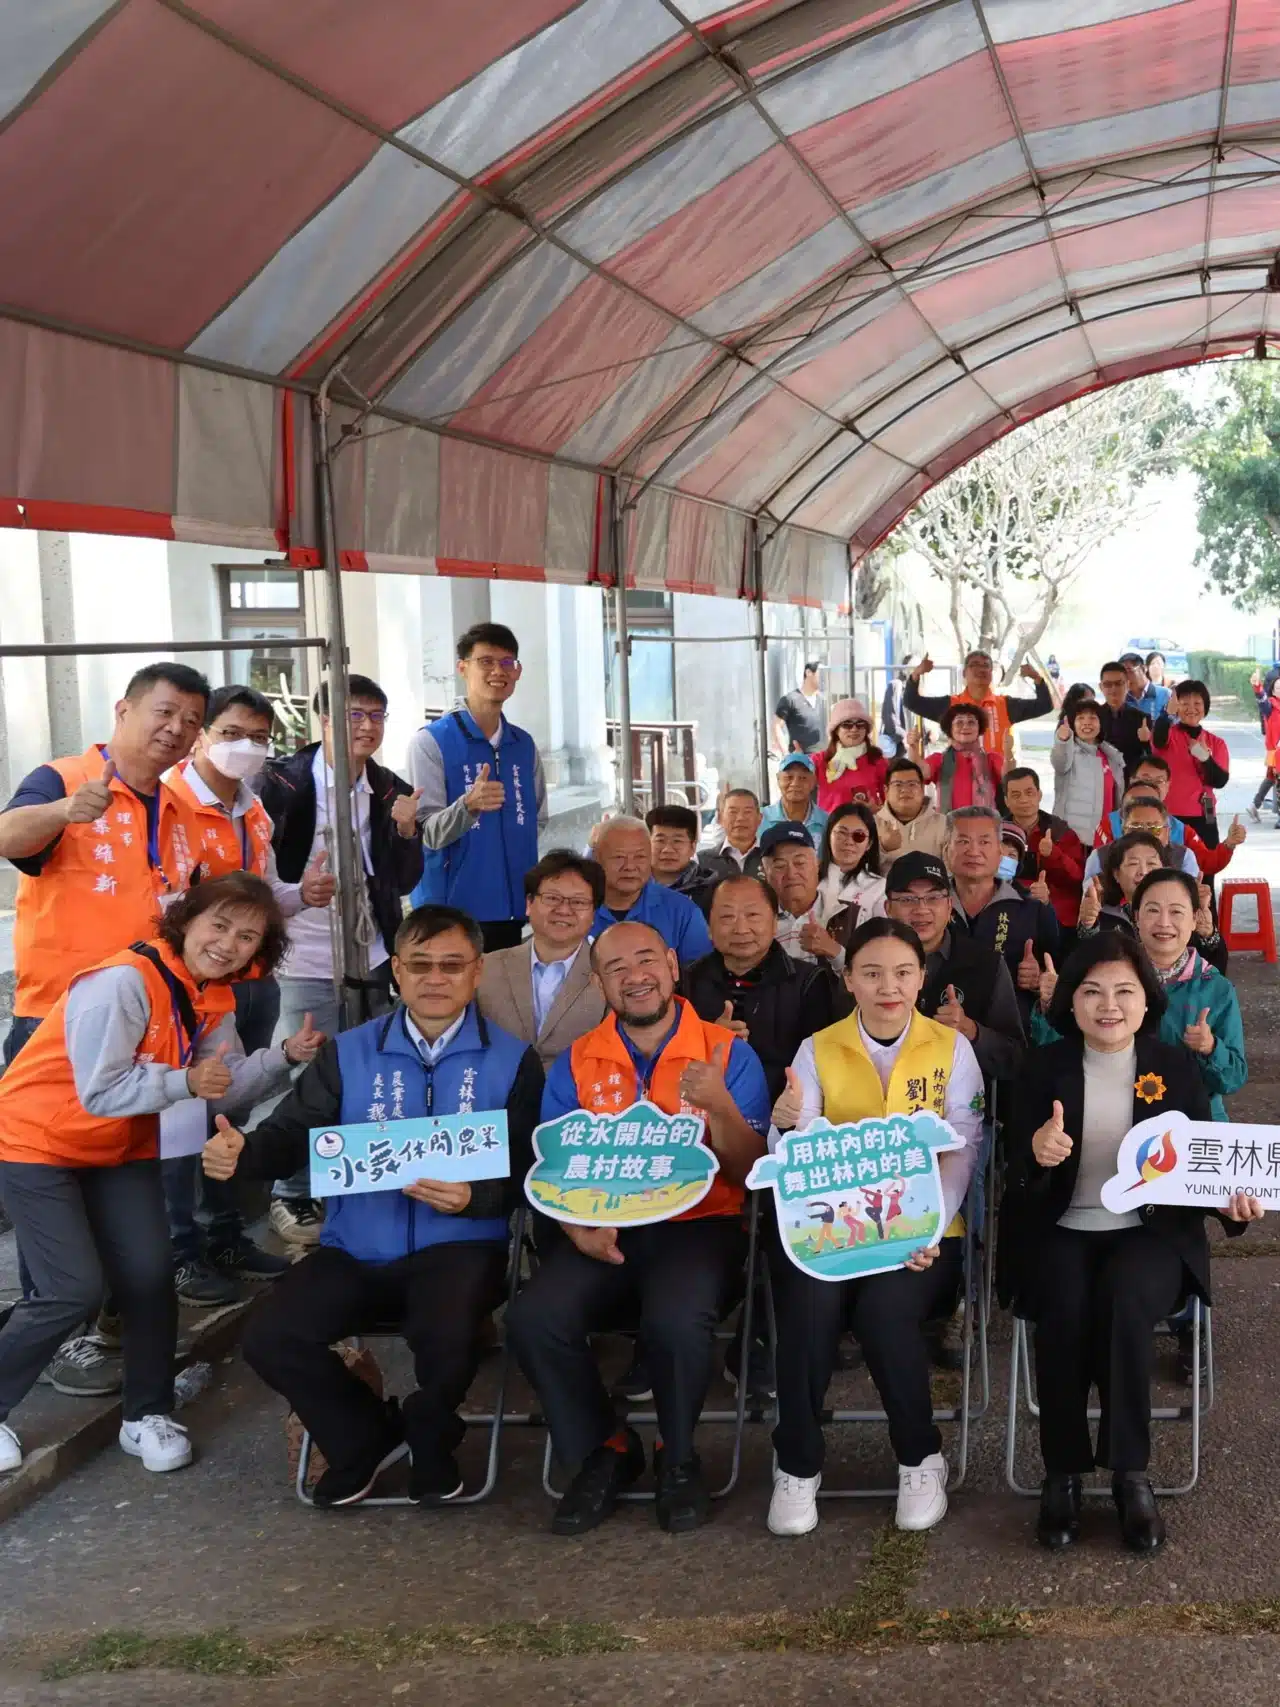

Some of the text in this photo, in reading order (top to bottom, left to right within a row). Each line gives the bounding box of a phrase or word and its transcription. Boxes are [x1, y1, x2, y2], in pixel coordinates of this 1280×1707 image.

[932, 1067, 945, 1115] 林內鄉
[559, 1120, 697, 1147] 從水開始的
[792, 1123, 911, 1167] 用林內的水
[563, 1153, 676, 1181] 農村故事
[783, 1146, 927, 1195] 舞出林內的美
[1184, 1183, 1232, 1197] YUNLIN
